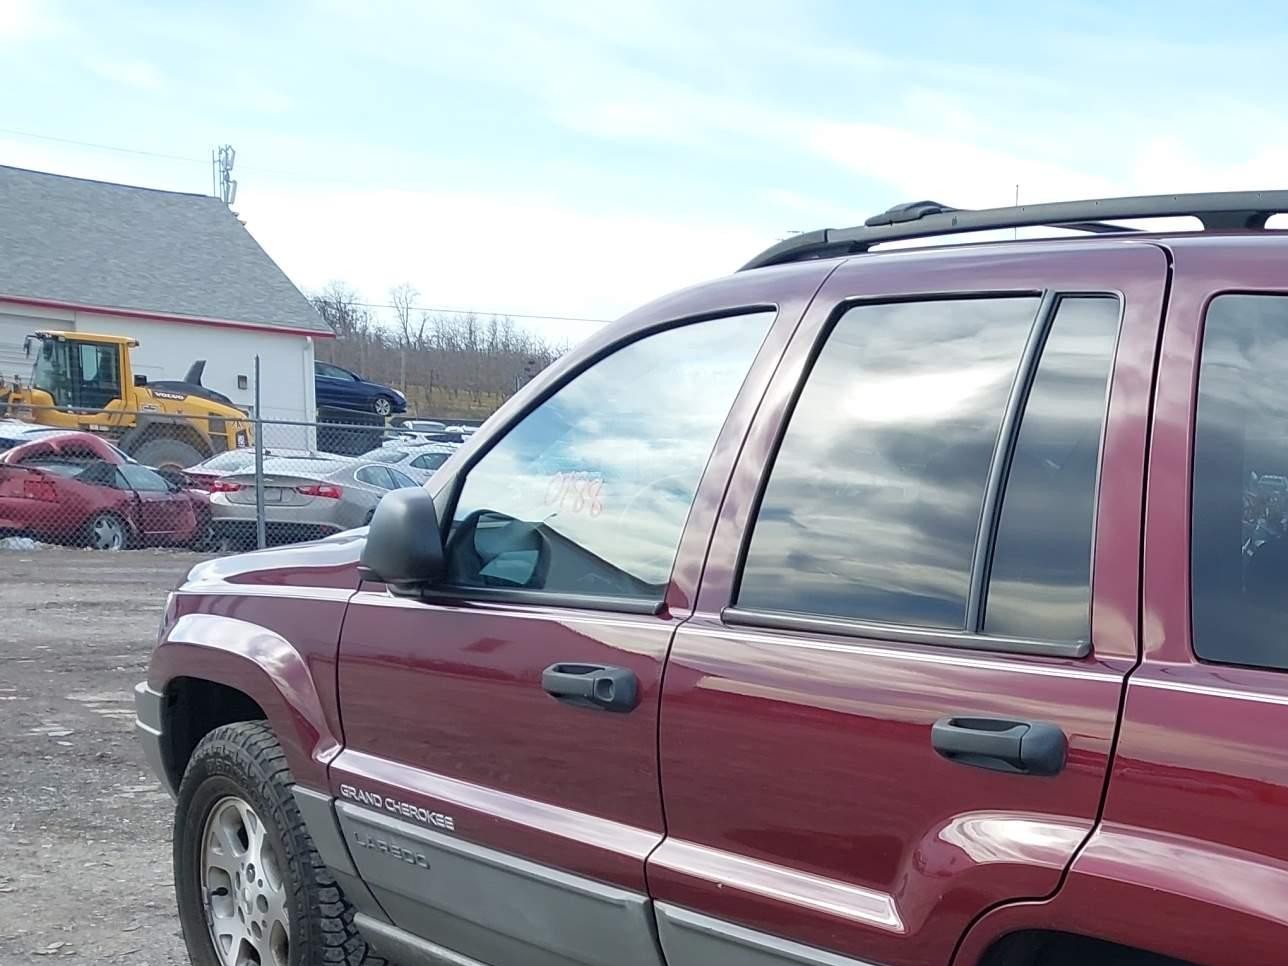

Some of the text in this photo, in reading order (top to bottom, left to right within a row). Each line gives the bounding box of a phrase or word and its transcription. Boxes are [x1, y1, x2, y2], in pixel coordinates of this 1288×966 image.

[154, 391, 185, 400] VOLVO
[339, 784, 455, 831] GRAND CHEROKEE
[353, 831, 431, 870] LAREDO
